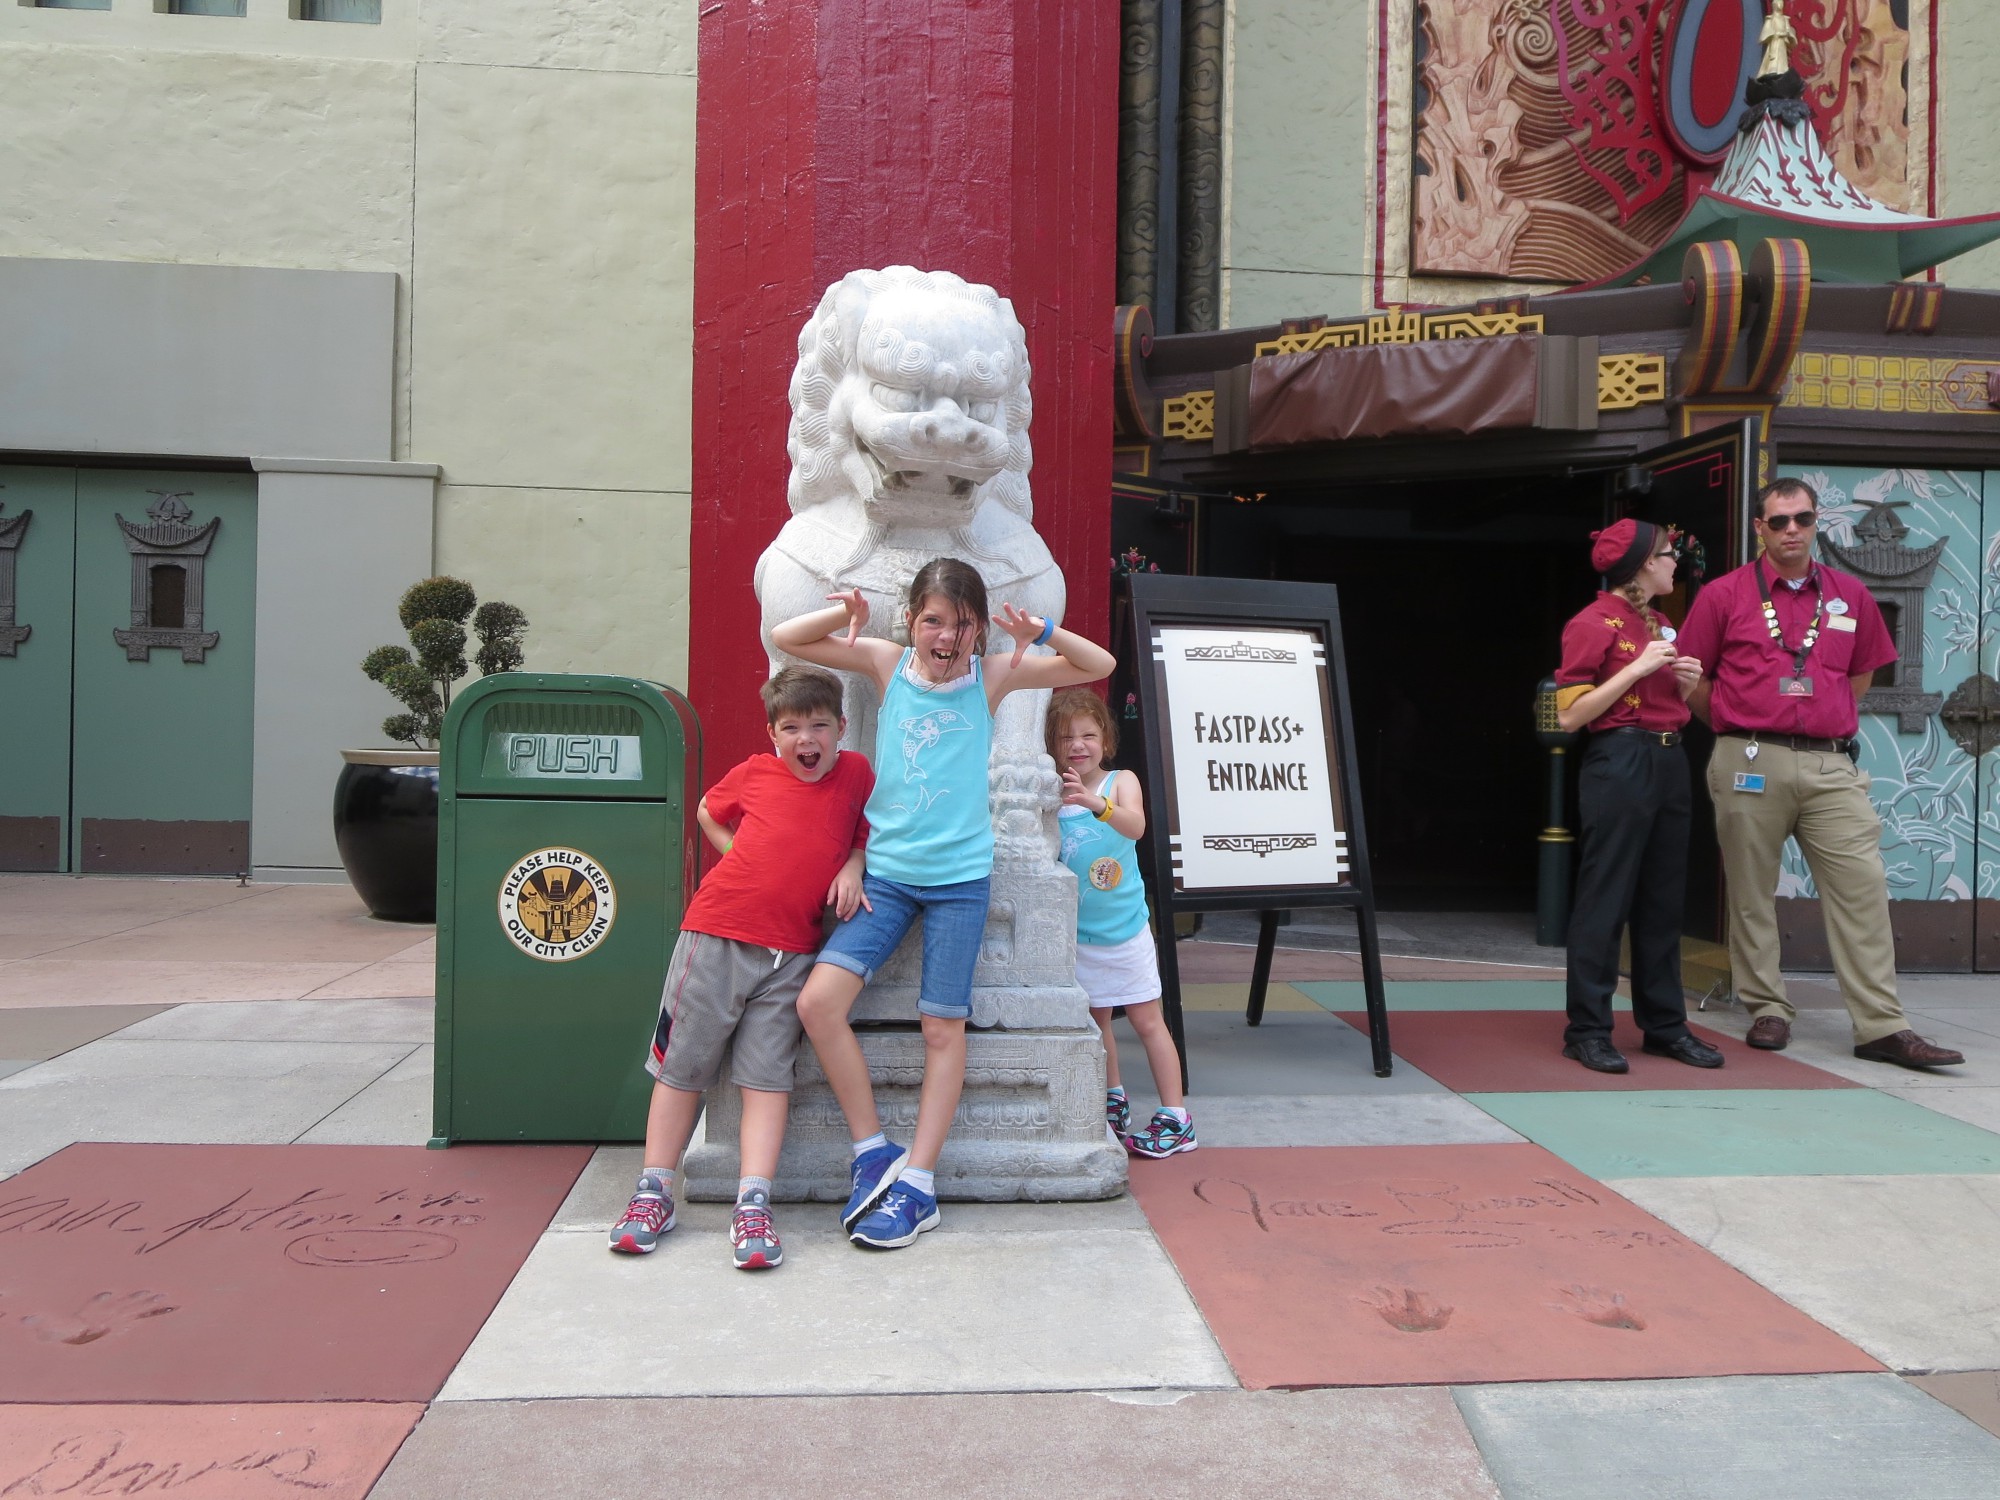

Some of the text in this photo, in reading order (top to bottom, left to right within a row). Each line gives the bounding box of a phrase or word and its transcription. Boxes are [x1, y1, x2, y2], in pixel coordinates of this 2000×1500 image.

[1194, 711, 1304, 743] FASTPASS+
[507, 735, 619, 773] PUSH
[1207, 760, 1309, 791] ENTRANCE
[504, 851, 610, 897] PLEASE HELP KEEP
[507, 916, 608, 957] OUR CITY CLEAN
